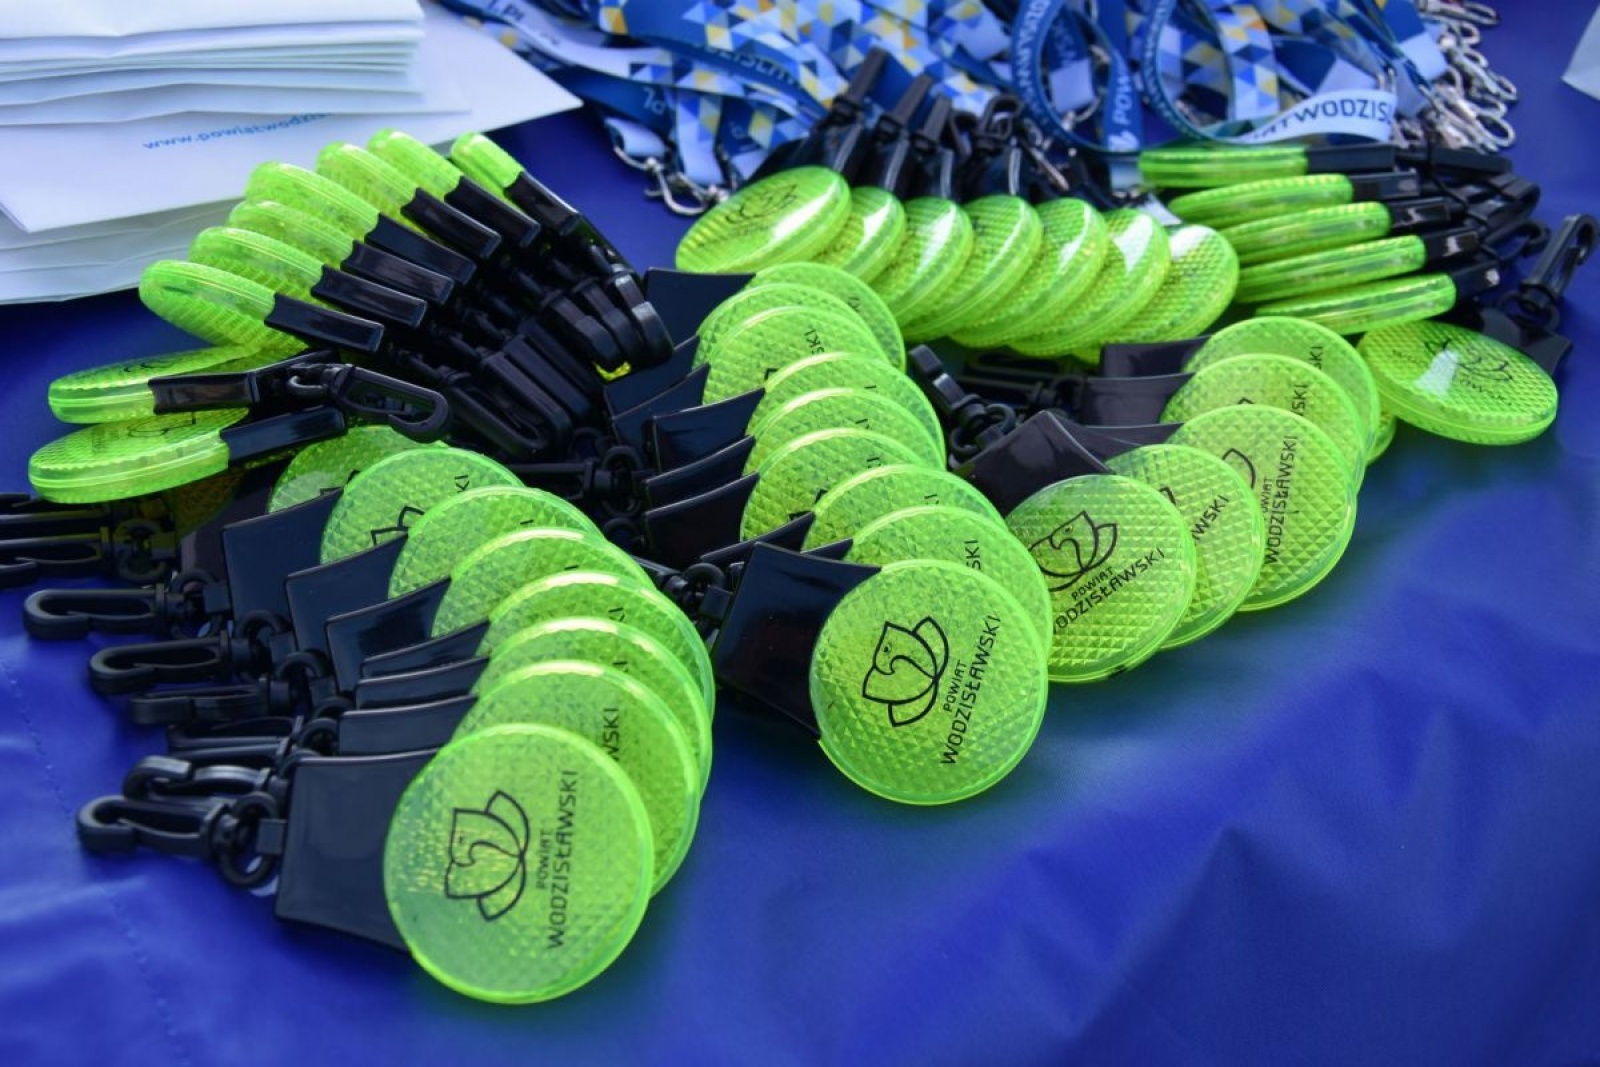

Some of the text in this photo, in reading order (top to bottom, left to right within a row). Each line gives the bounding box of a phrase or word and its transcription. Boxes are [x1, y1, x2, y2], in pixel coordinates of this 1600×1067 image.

[1291, 384, 1308, 416] SKI
[1264, 435, 1298, 565] WODZISŁAWSKI
[1071, 566, 1114, 598] POWIAT
[940, 615, 1001, 765] WODZISŁAWSKI
[943, 660, 964, 712] POWIAT
[536, 828, 553, 890] POWIAT
[547, 770, 578, 949] WODZISŁAWSKI
